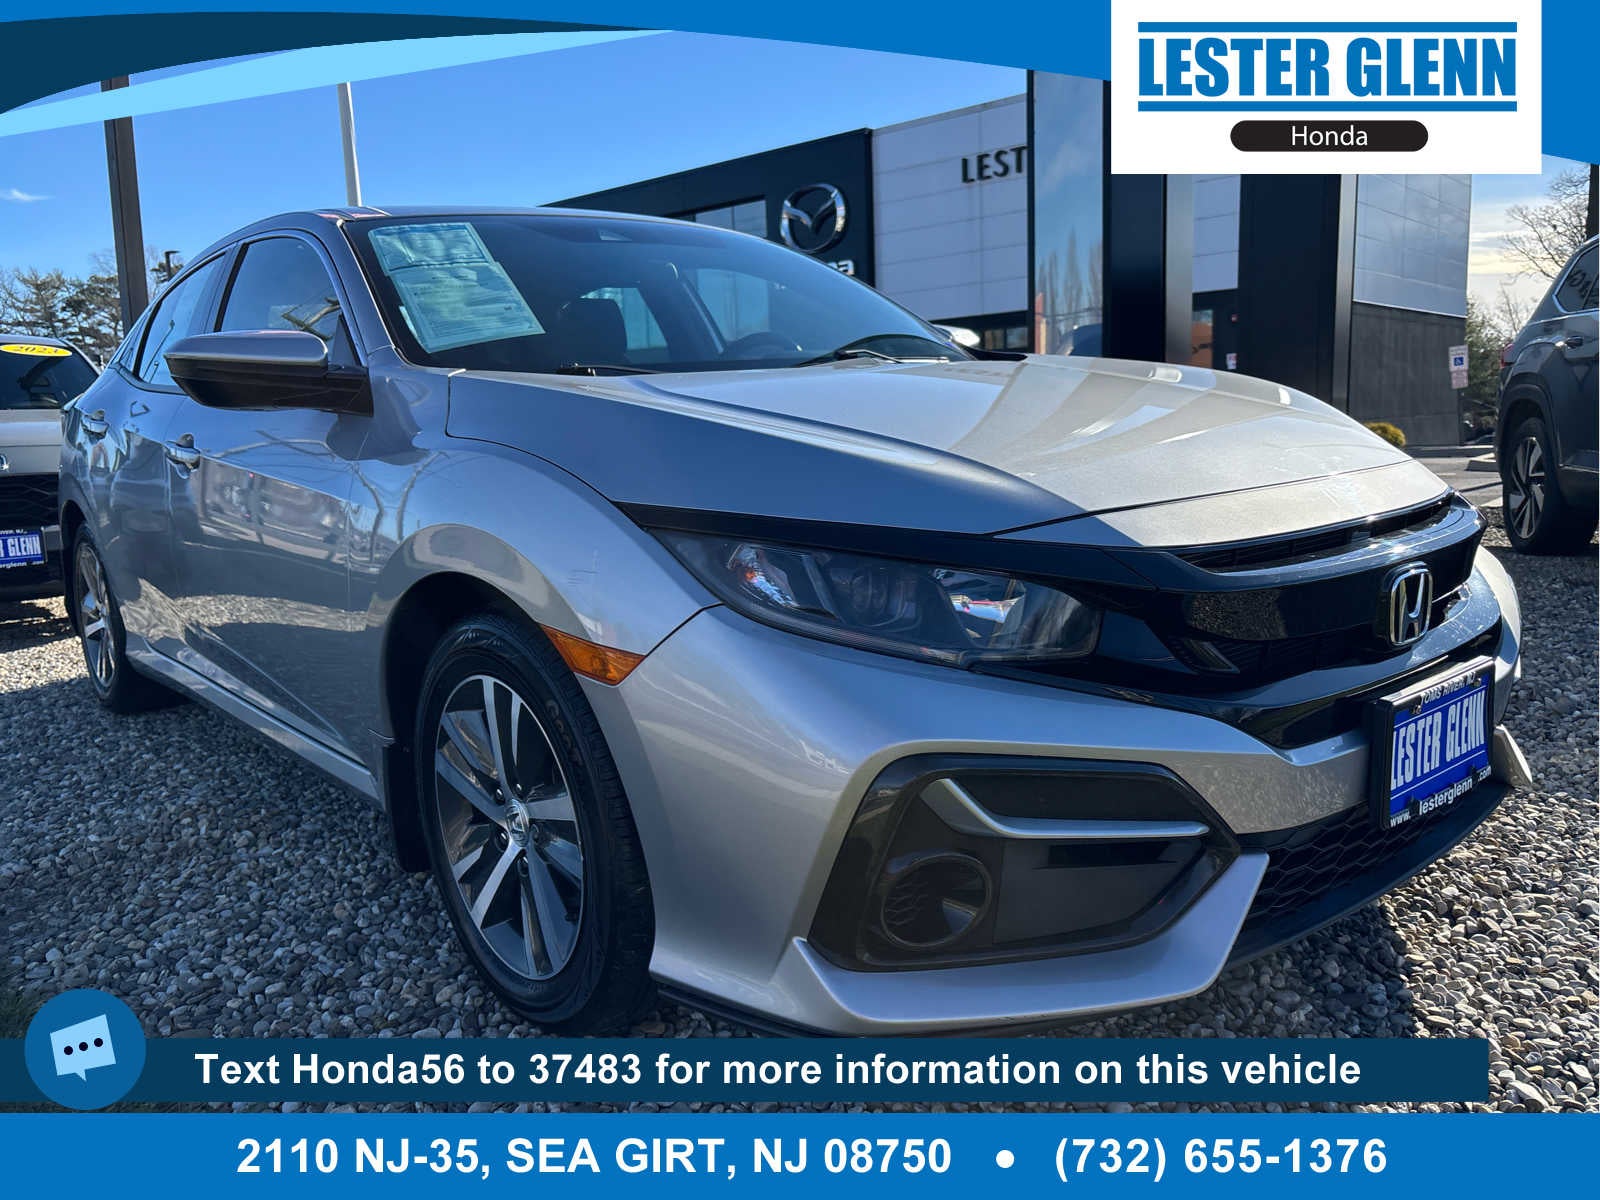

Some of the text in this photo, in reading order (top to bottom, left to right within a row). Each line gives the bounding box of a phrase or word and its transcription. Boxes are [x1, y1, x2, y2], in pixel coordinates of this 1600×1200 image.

[7, 536, 42, 557] GLENN
[1391, 690, 1486, 792] LESTER GLENN
[1390, 765, 1492, 828] www. lesterglenn .com
